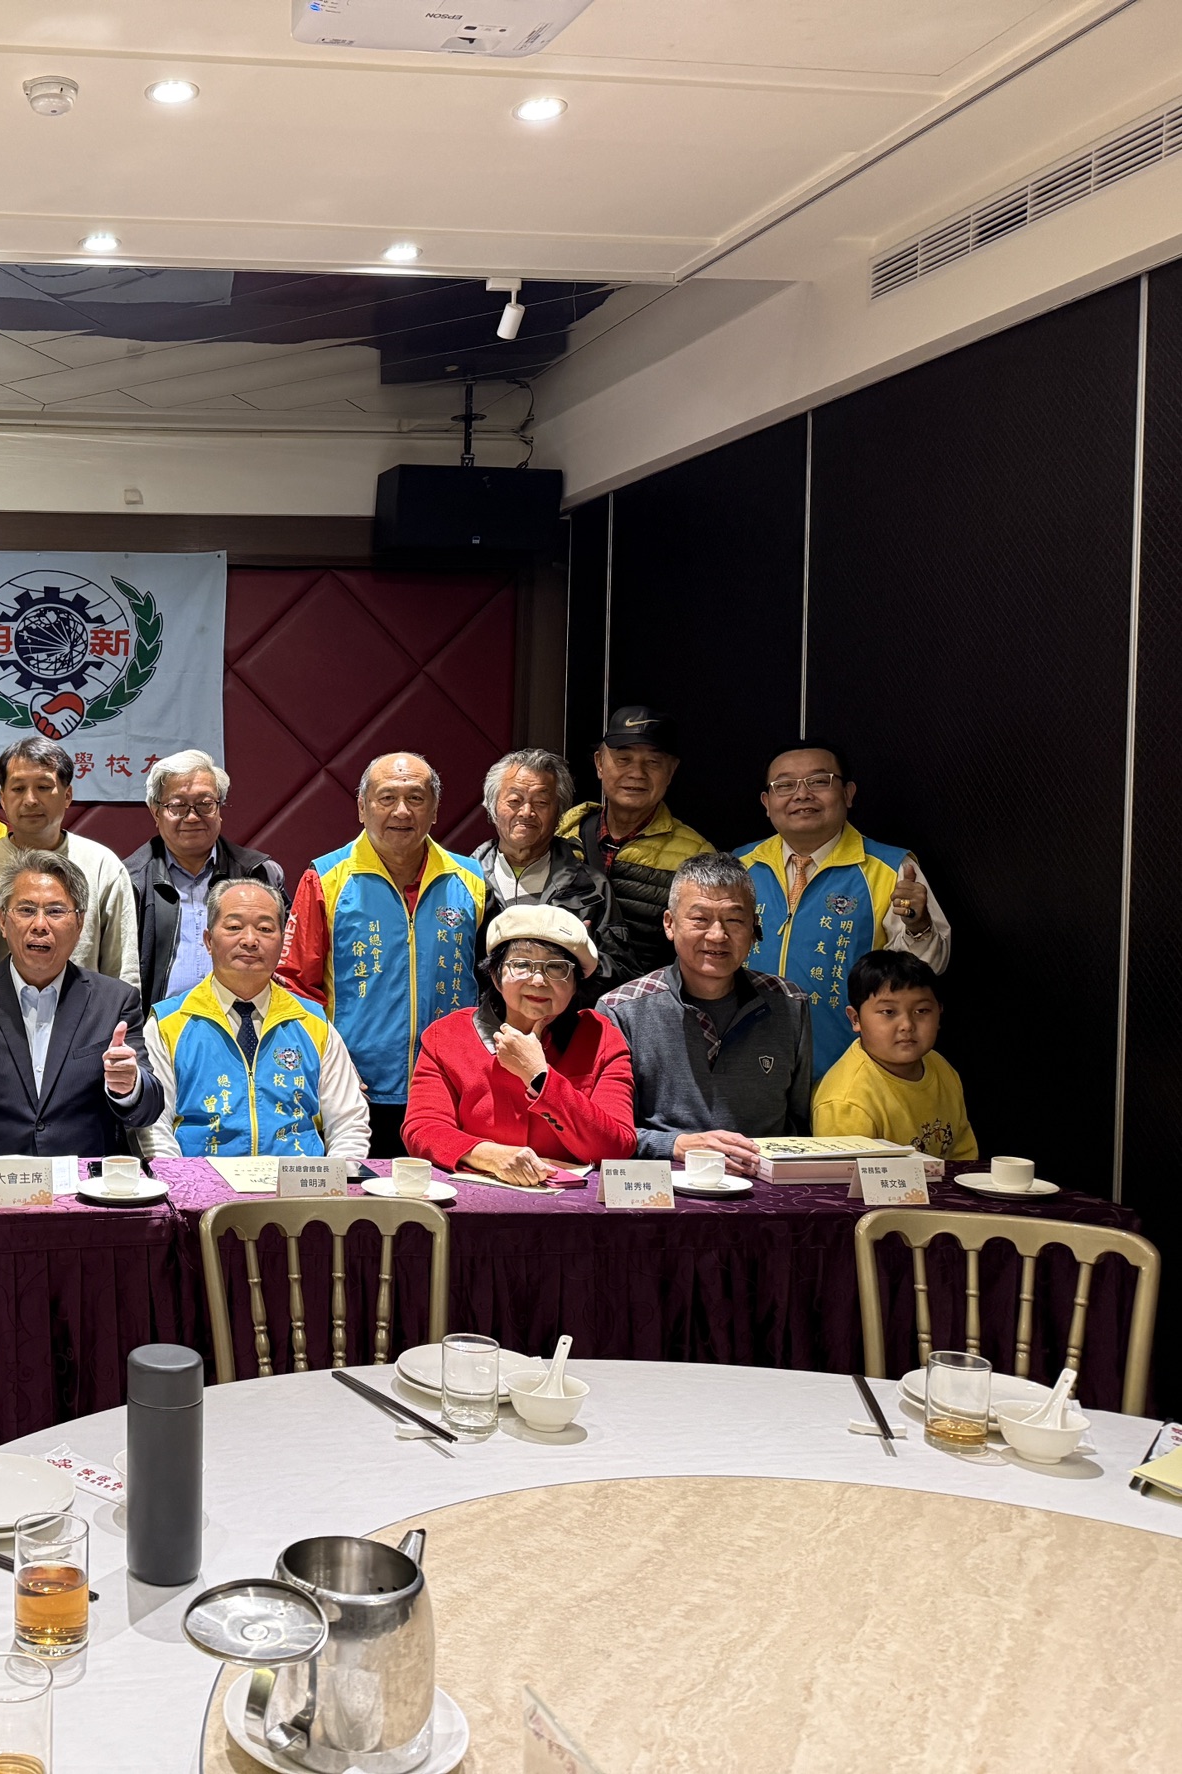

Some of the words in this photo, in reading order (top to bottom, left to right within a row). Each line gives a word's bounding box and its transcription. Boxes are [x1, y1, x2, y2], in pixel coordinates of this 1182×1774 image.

[424, 12, 463, 20] EPSON
[88, 627, 129, 656] 新
[368, 920, 383, 974] 副總會長
[808, 915, 833, 1005] 校友總會
[828, 920, 854, 1009] 明新科技大學
[217, 1073, 233, 1115] 總會長
[281, 1165, 330, 1173] 校友總會總會長
